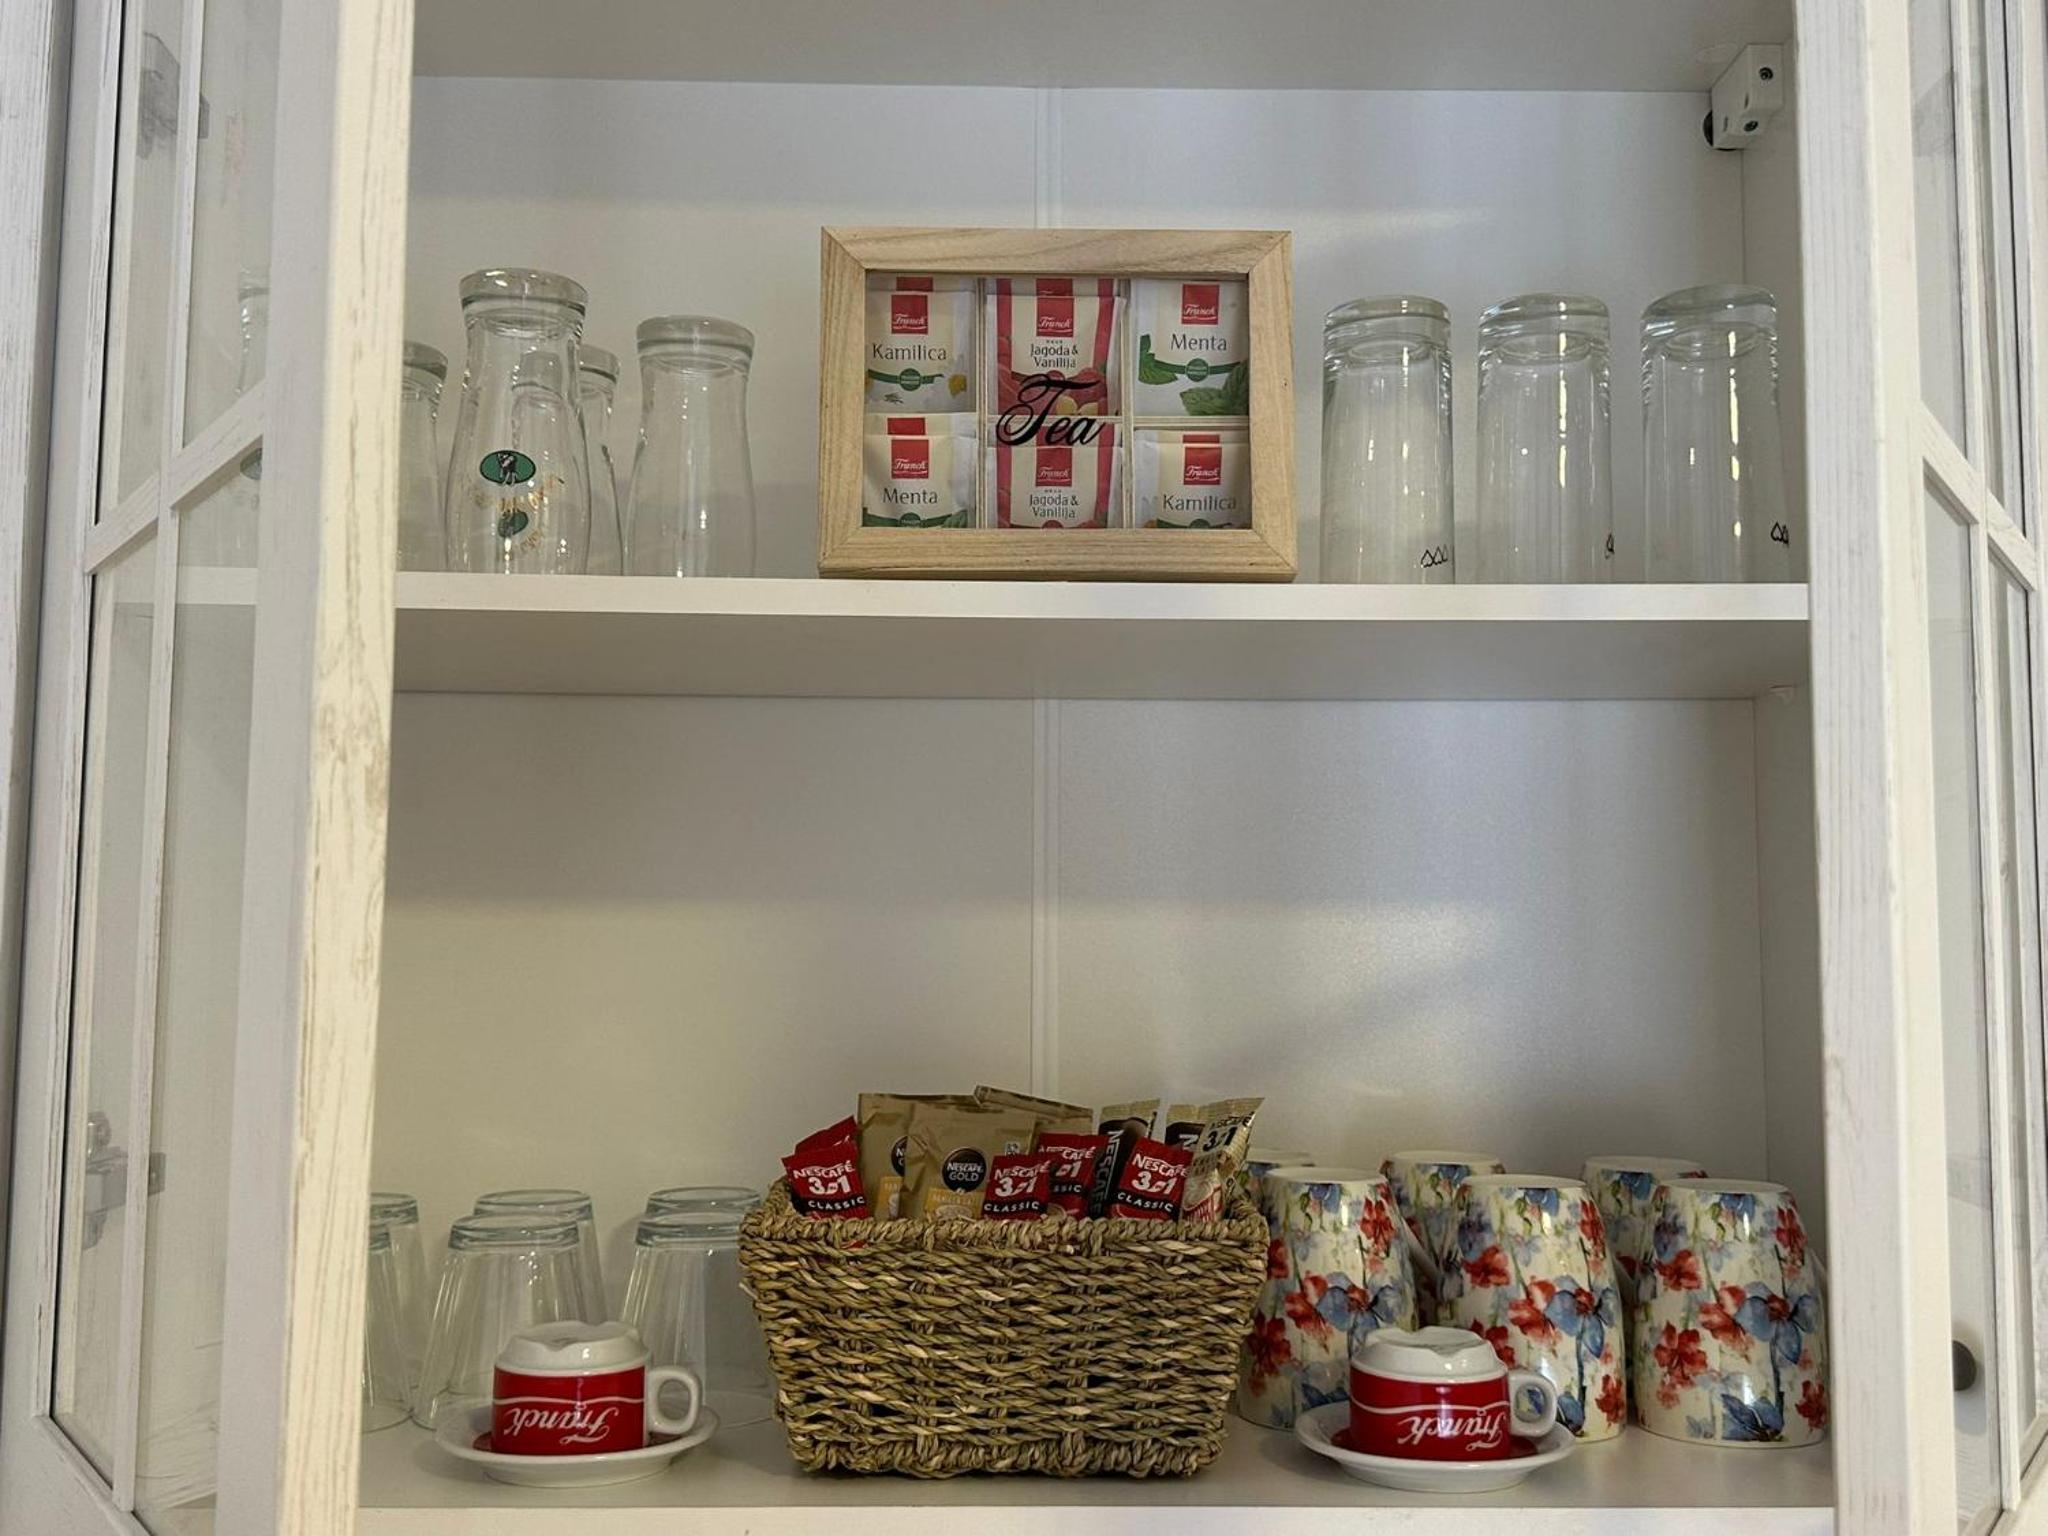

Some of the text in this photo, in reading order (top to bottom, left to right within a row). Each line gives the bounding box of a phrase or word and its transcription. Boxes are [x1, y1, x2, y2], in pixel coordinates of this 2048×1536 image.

[1030, 344, 1079, 357] Jagoda &
[1170, 333, 1227, 351] Menta
[872, 342, 947, 361] Kamilica
[995, 373, 1107, 446] Tea
[882, 487, 938, 505] Menta
[1029, 494, 1080, 507] Jagoda &
[1163, 494, 1237, 512] Kamilica
[948, 1171, 980, 1182] GOLD
[808, 1196, 865, 1210] CLASSIC
[984, 1201, 1040, 1213] CLASSIC
[1117, 1192, 1174, 1213] CLASSIC
